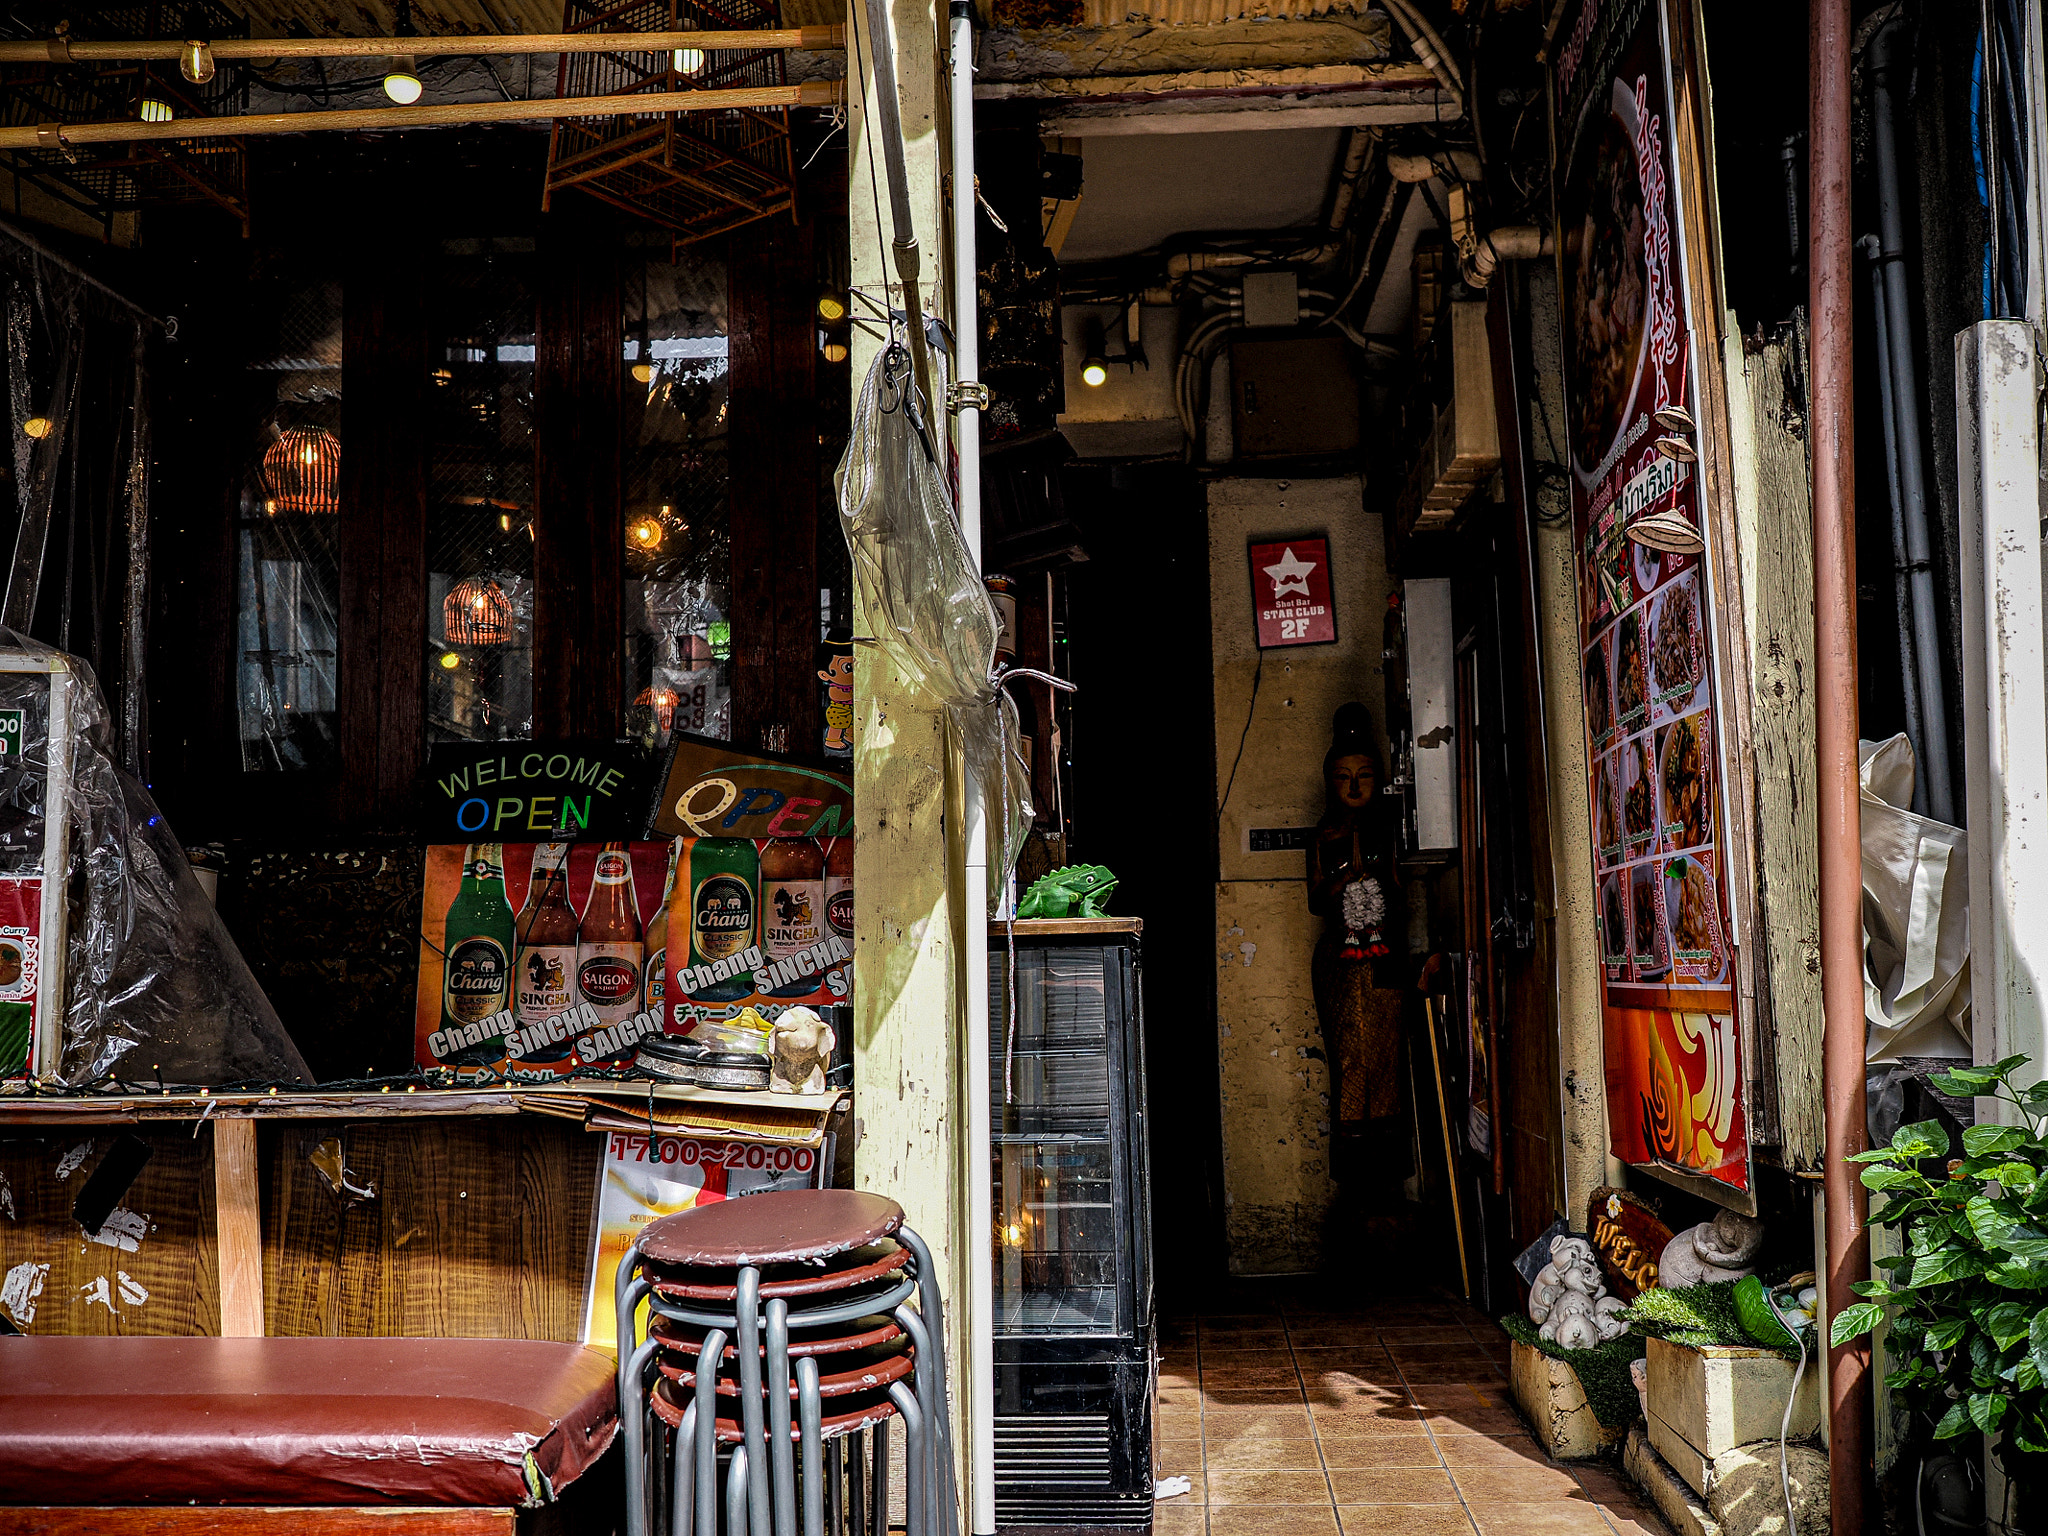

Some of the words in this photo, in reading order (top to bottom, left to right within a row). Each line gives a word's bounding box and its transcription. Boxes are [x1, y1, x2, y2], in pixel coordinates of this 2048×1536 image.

[1263, 608, 1294, 620] STAR
[1295, 605, 1325, 617] CLUB
[1275, 600, 1293, 609] Shot
[1296, 598, 1311, 607] Bar
[1281, 618, 1309, 639] 2F
[438, 753, 625, 799] WELCOME
[457, 795, 592, 832] OPEN
[675, 777, 854, 838] OPEN
[697, 910, 750, 929] Chang
[3, 926, 28, 937] Curry
[703, 932, 743, 942] CLASSIC
[767, 927, 819, 940] SINGHA
[23, 937, 37, 996] マッサマン
[676, 944, 765, 996] Chang
[752, 935, 851, 996] SINCHA
[449, 972, 503, 992] Chang
[583, 972, 631, 986] SAIGON
[455, 995, 497, 1005] CLASSIC
[519, 992, 571, 1006] SINGHA
[427, 1007, 516, 1059] Chang
[503, 1001, 600, 1060] SINCHA
[611, 1136, 814, 1172] 1700～20:00
[1593, 1214, 1660, 1293] WELC
